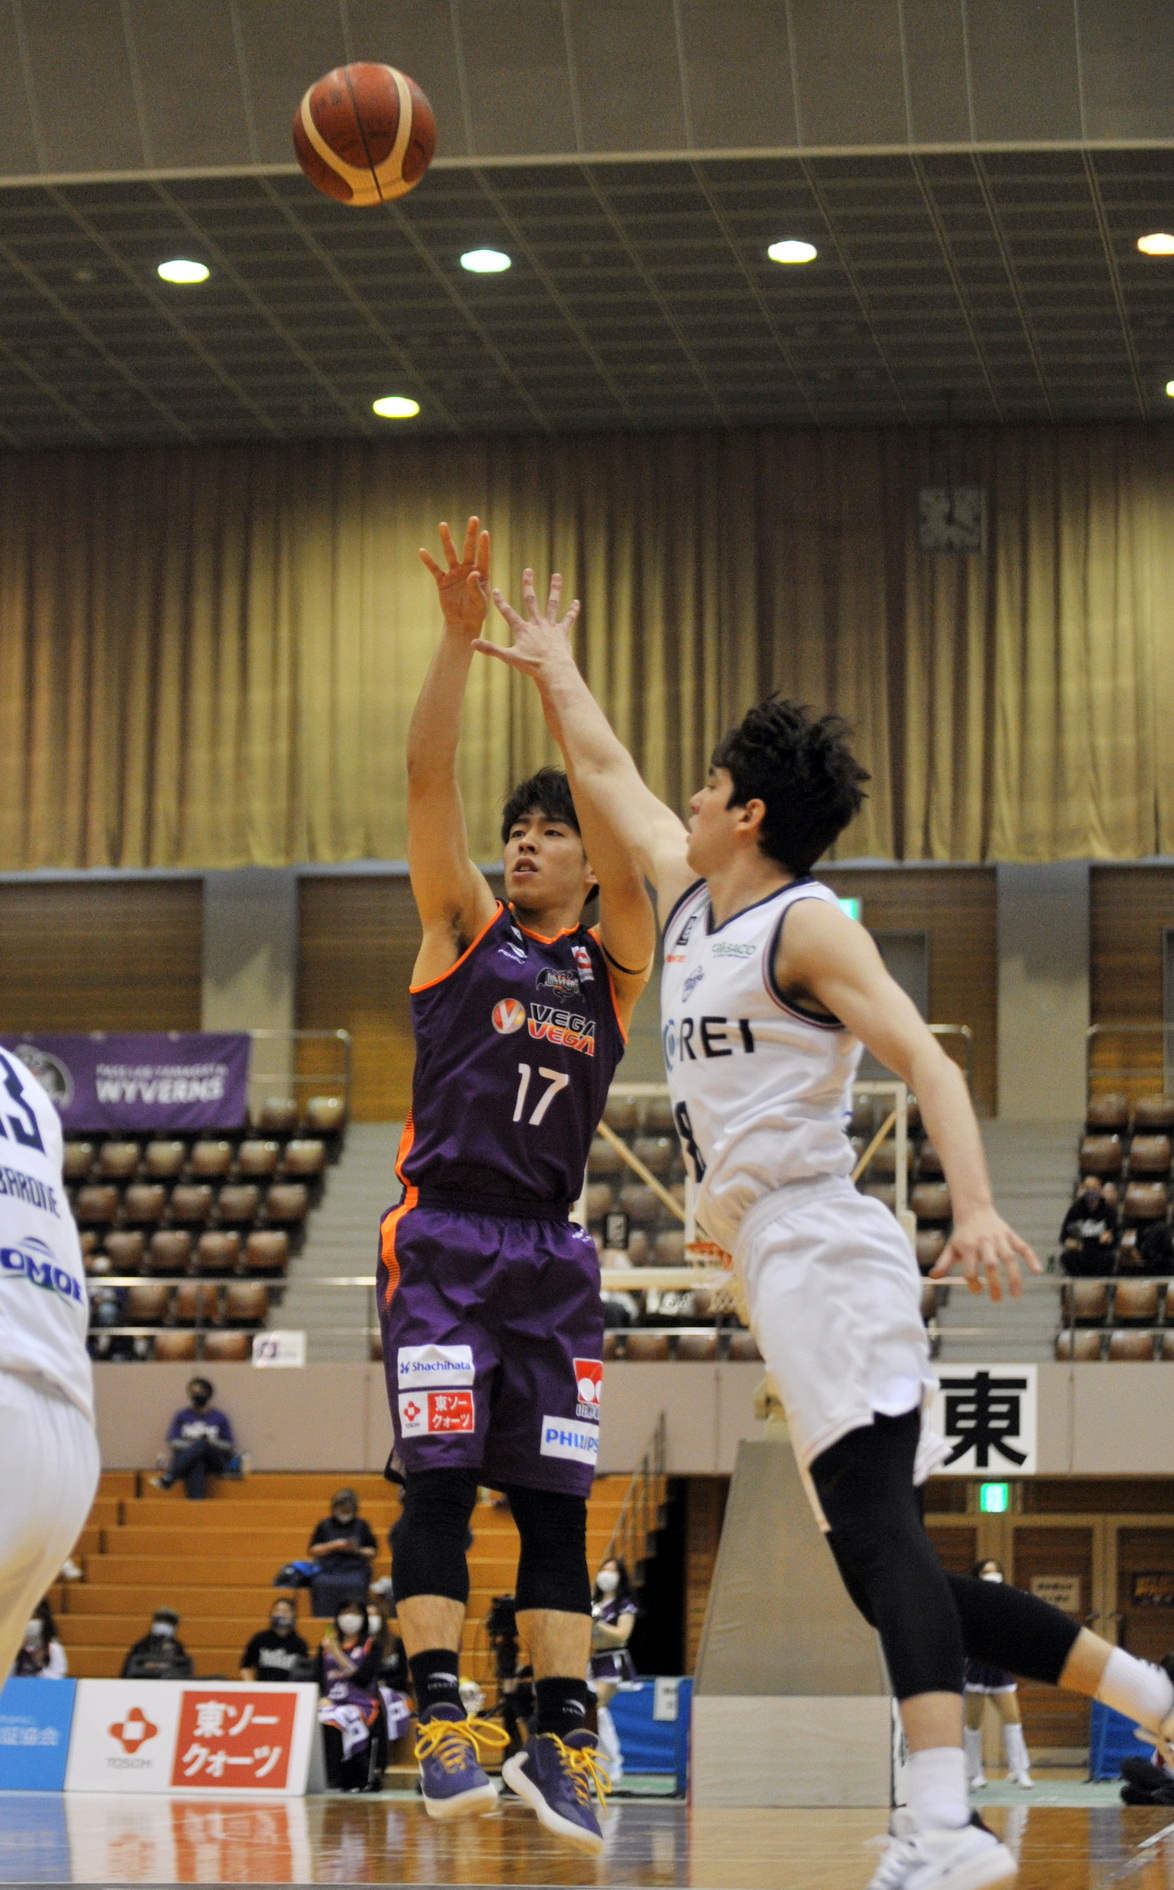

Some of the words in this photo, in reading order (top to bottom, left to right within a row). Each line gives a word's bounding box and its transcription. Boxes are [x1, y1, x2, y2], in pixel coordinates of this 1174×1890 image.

[530, 1003, 596, 1037] VEGA
[527, 1018, 595, 1057] VEGA
[96, 1077, 224, 1104] WYVERNS
[513, 1063, 569, 1126] 17
[412, 1360, 471, 1371] Shachihata
[434, 1395, 467, 1411] 東ソー
[939, 1371, 1028, 1467] 東
[432, 1413, 470, 1429] クォーツ
[545, 1428, 598, 1453] PHILIPS
[192, 1700, 279, 1738] 東ソー
[181, 1743, 282, 1778] クォーツ
